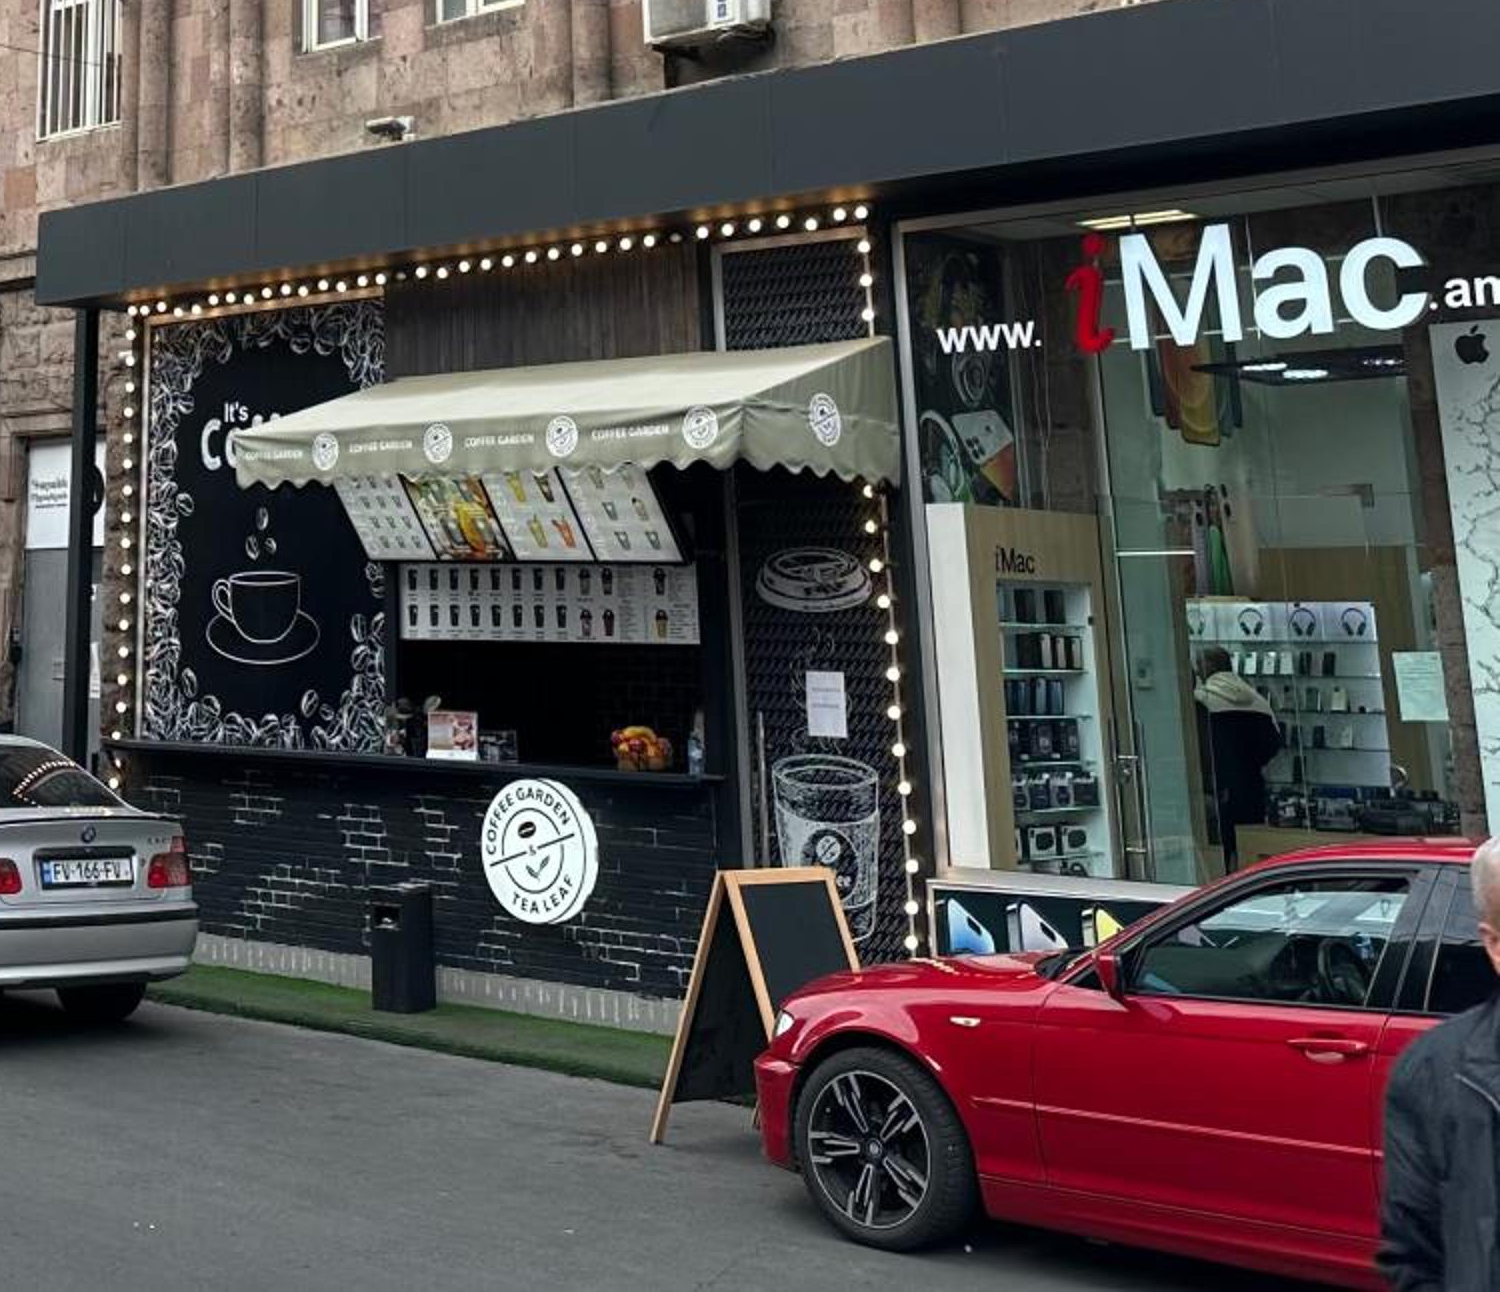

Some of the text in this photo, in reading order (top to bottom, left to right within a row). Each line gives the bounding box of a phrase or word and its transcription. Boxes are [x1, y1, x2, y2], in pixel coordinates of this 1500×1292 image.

[223, 400, 249, 423] It's
[486, 787, 571, 855] COFFEE GARDEN
[512, 874, 573, 914] TEA LEAF
